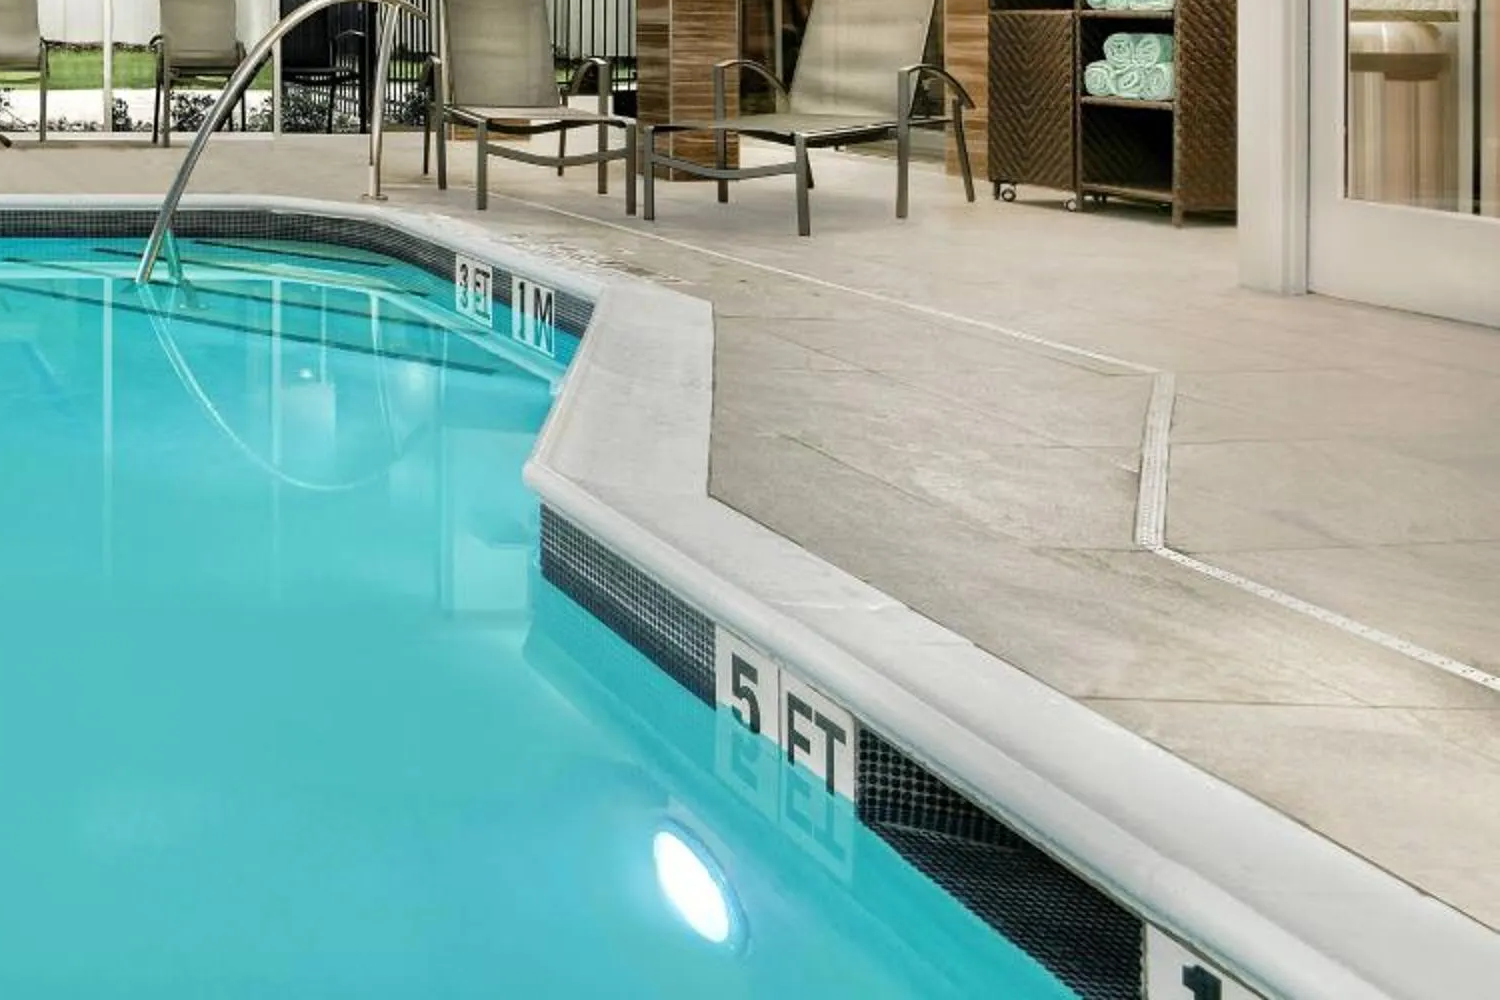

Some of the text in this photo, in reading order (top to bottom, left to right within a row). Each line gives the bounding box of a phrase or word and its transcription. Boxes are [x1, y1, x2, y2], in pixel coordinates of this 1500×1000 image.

[518, 281, 553, 326] 1 M
[731, 651, 847, 796] 5 FT
